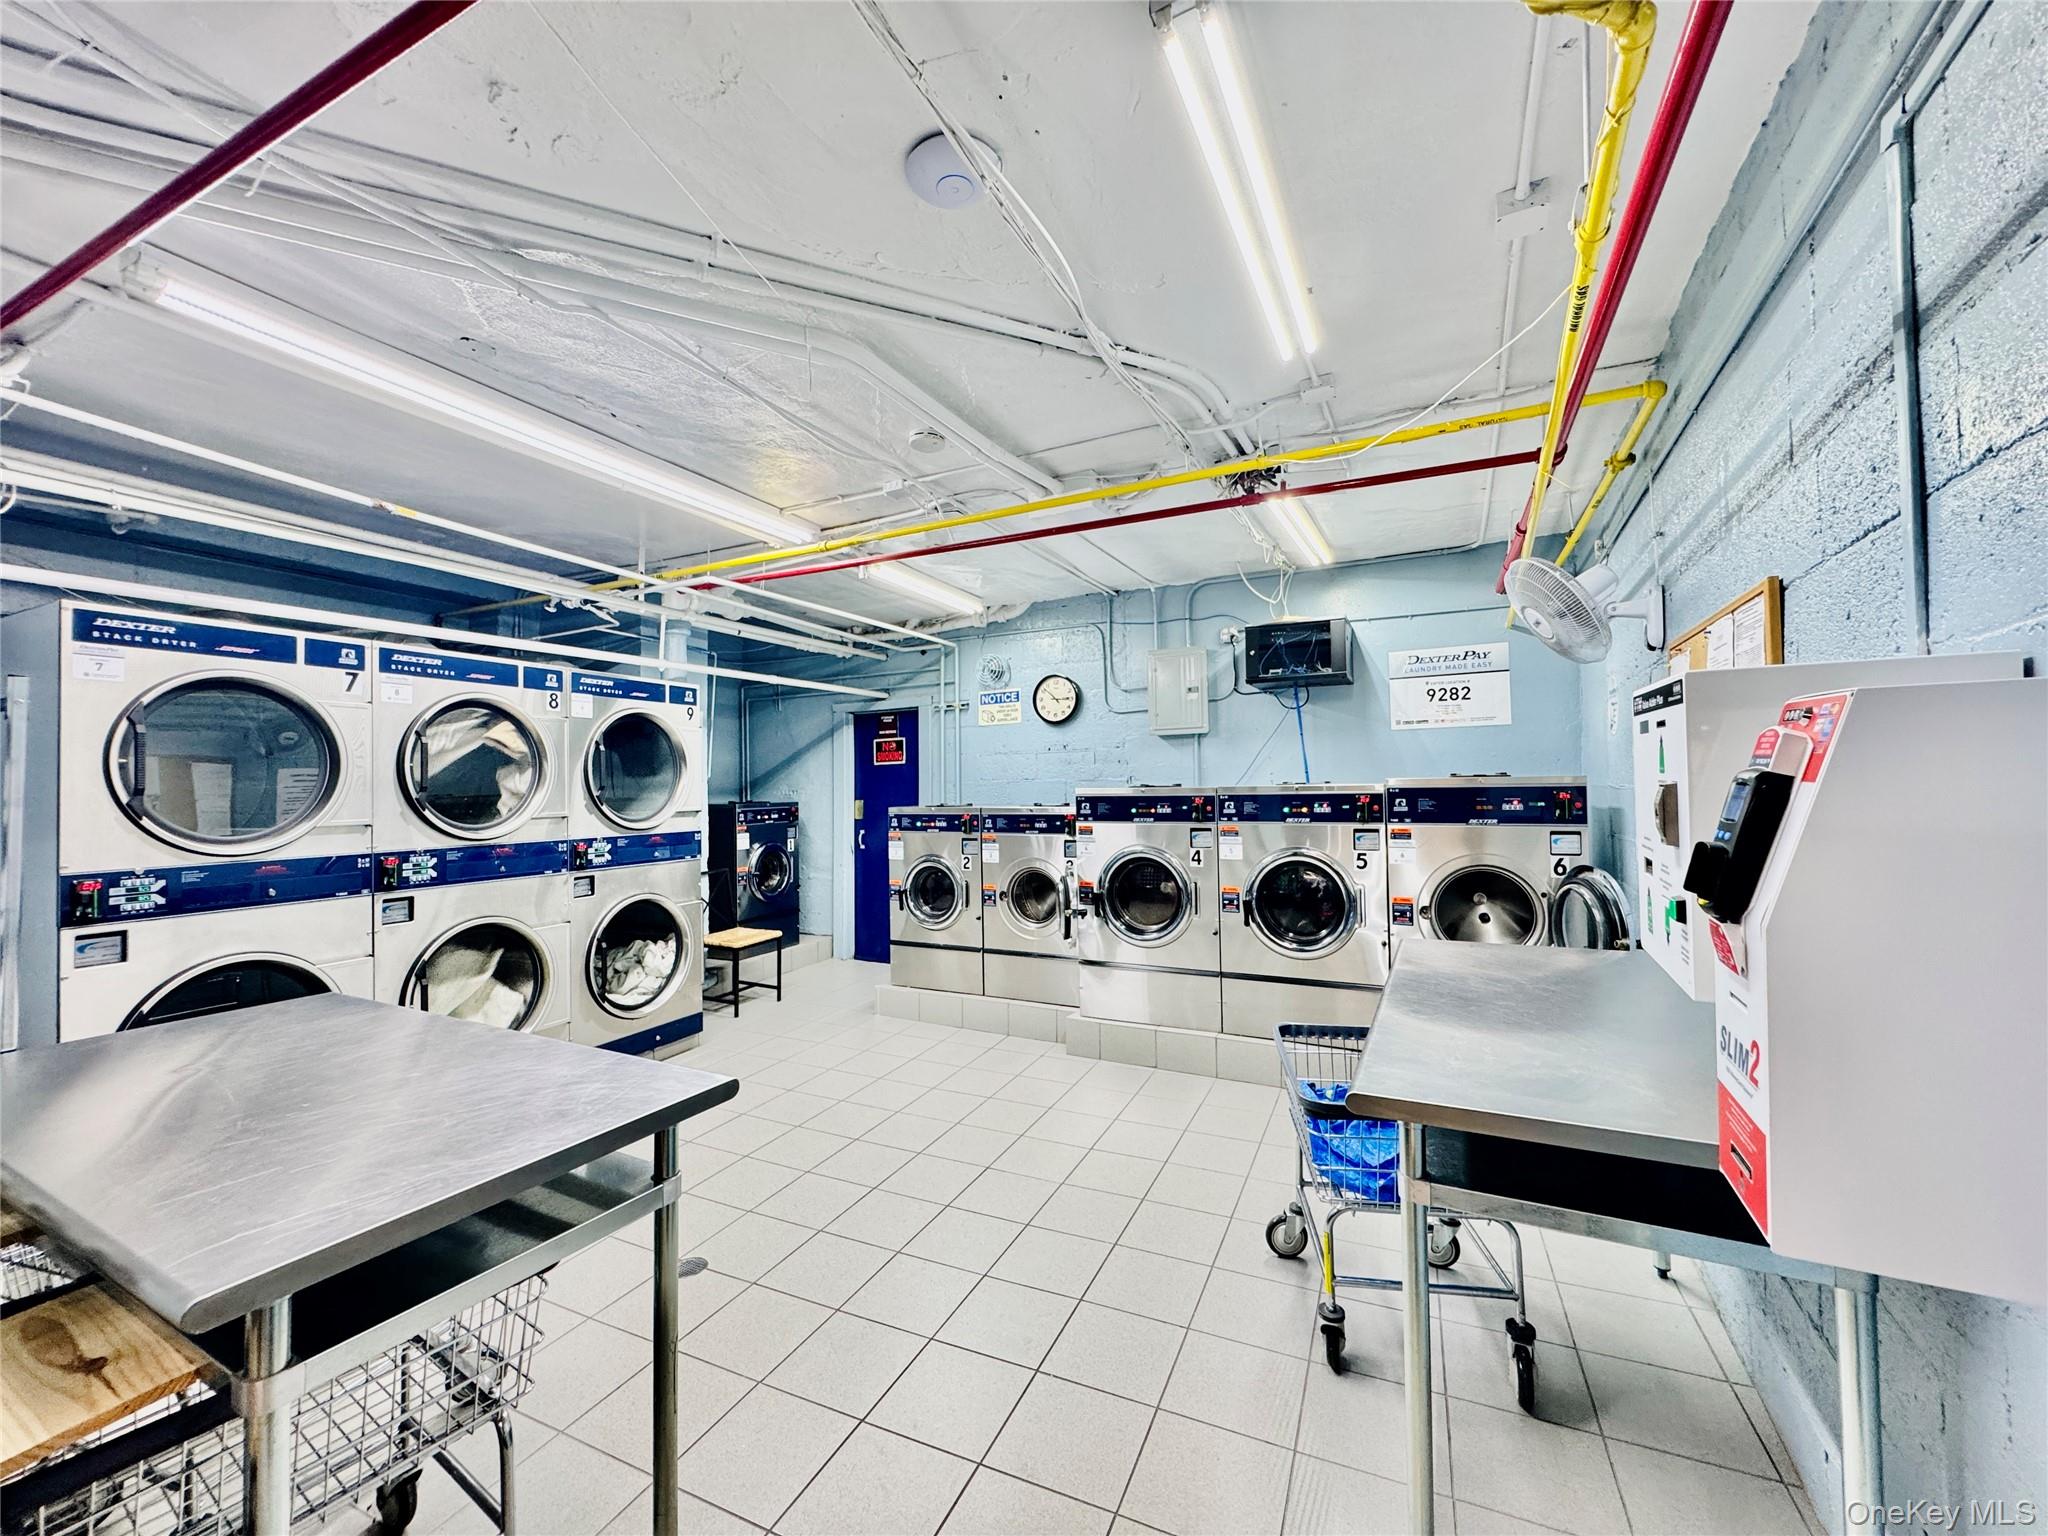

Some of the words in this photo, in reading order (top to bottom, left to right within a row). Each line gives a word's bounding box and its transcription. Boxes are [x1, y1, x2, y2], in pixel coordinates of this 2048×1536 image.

[93, 617, 177, 634] DEXTER
[92, 630, 143, 642] STACK
[151, 637, 197, 648] DRYER
[391, 653, 442, 666] DEXTER
[391, 664, 422, 673] STACK
[1405, 665, 1441, 674] LAUNDRY
[1445, 663, 1467, 671] MADE
[1471, 661, 1493, 669] EASY
[345, 672, 359, 692] 7
[549, 692, 559, 709] 8
[981, 692, 1018, 704] NOTICE
[1426, 686, 1471, 702] 9282
[687, 707, 694, 720] 9
[882, 742, 897, 751] NO
[877, 751, 903, 761] SMOKING
[963, 857, 970, 870] 2
[1191, 850, 1202, 865] 4
[1356, 853, 1368, 869] 5
[1553, 858, 1567, 876] 6
